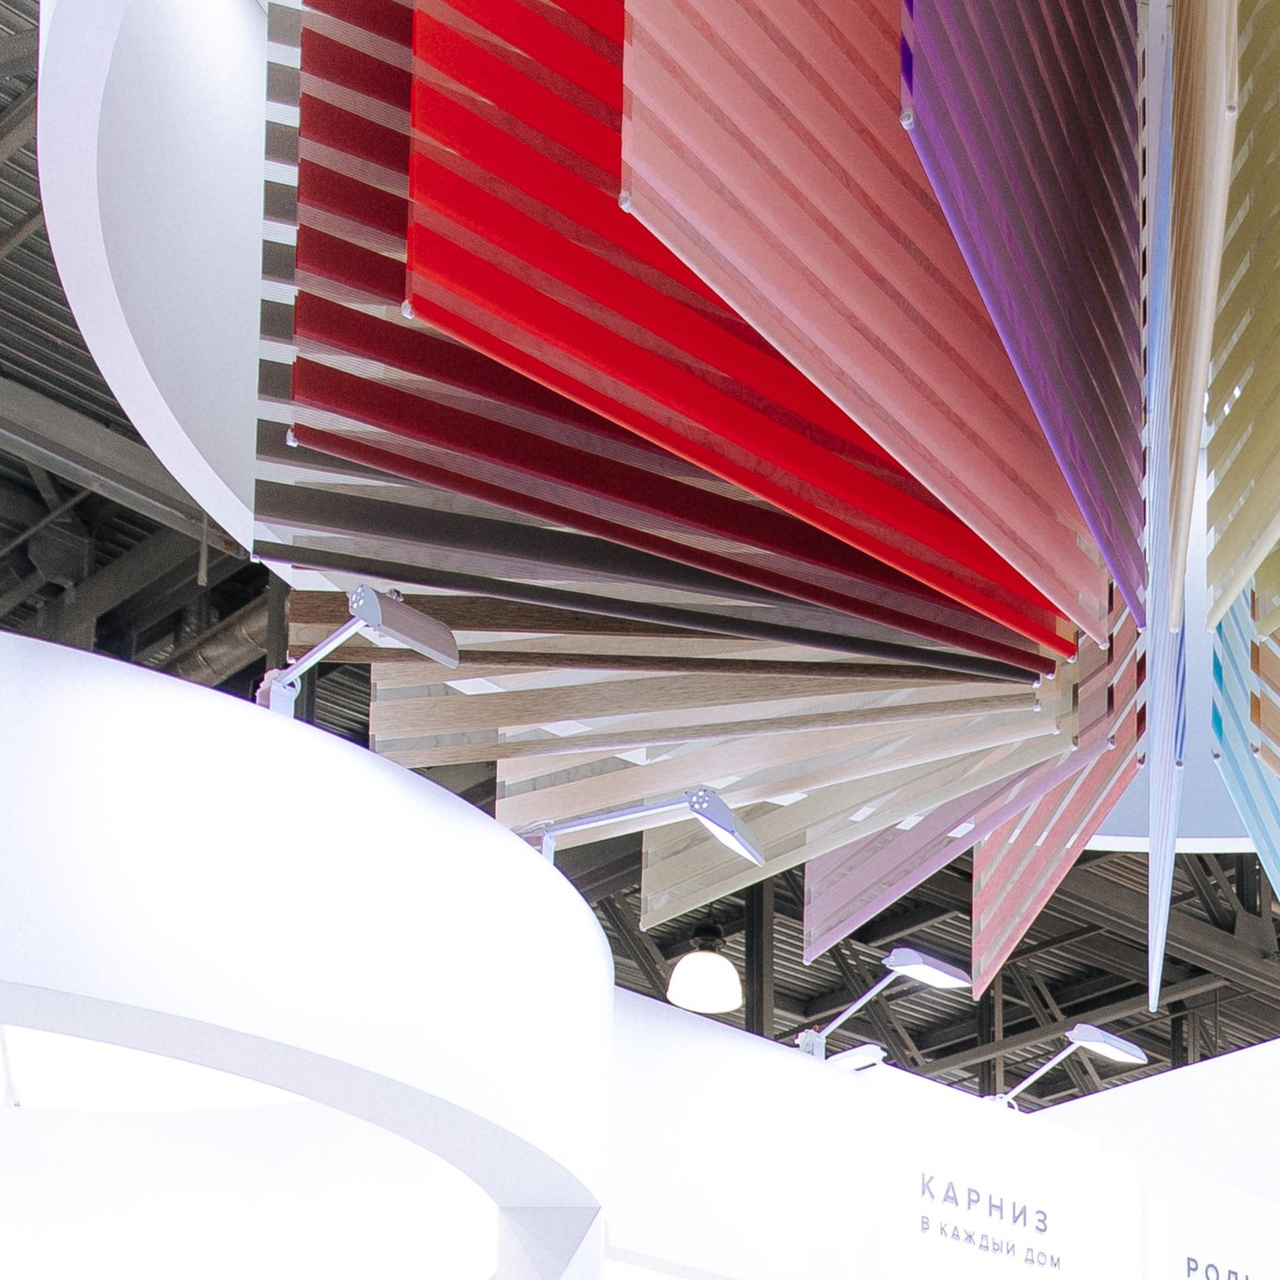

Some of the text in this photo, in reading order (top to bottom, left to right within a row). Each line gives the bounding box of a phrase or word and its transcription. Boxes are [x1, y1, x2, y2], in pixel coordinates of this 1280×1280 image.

[921, 1173, 1048, 1233] КАРНИЗ
[921, 1215, 1060, 1270] В КАЖДЫЙ ДОМ
